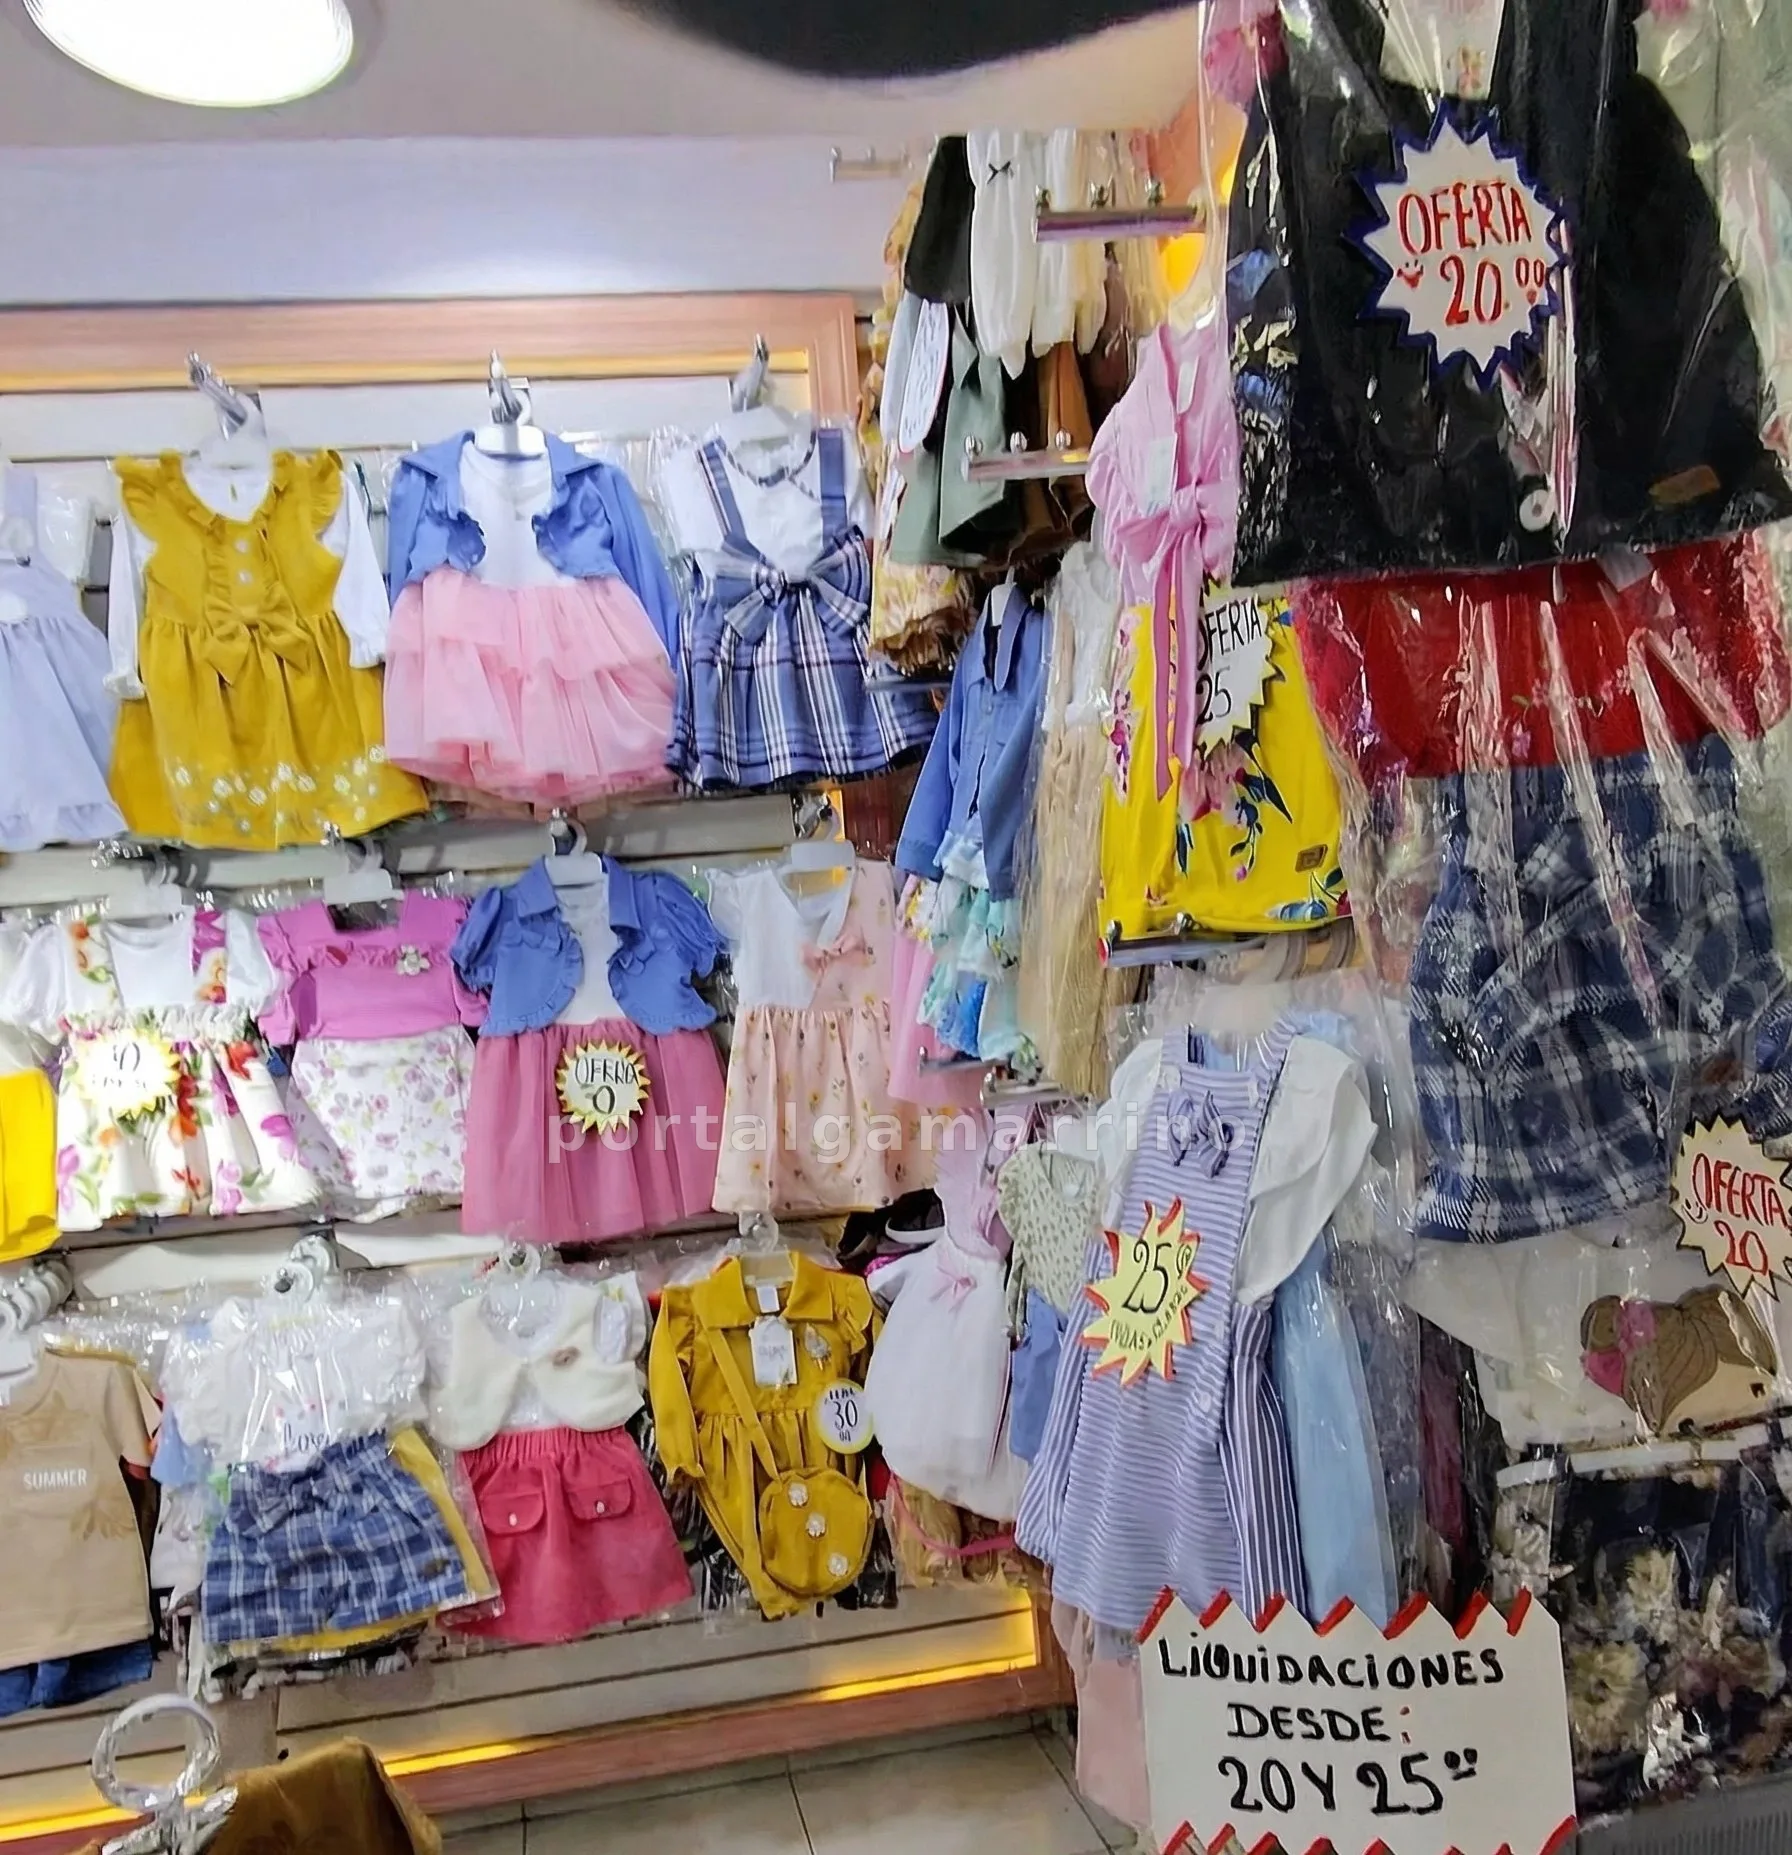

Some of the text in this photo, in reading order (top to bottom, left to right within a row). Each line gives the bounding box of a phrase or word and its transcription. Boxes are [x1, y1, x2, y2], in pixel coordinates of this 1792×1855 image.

[1398, 182, 1532, 254] OFERTA
[1195, 666, 1233, 725] 25
[1692, 1152, 1790, 1228] OFERTA
[1714, 1220, 1769, 1276] 20
[832, 1399, 858, 1430] 30
[23, 1468, 87, 1491] SUMMER
